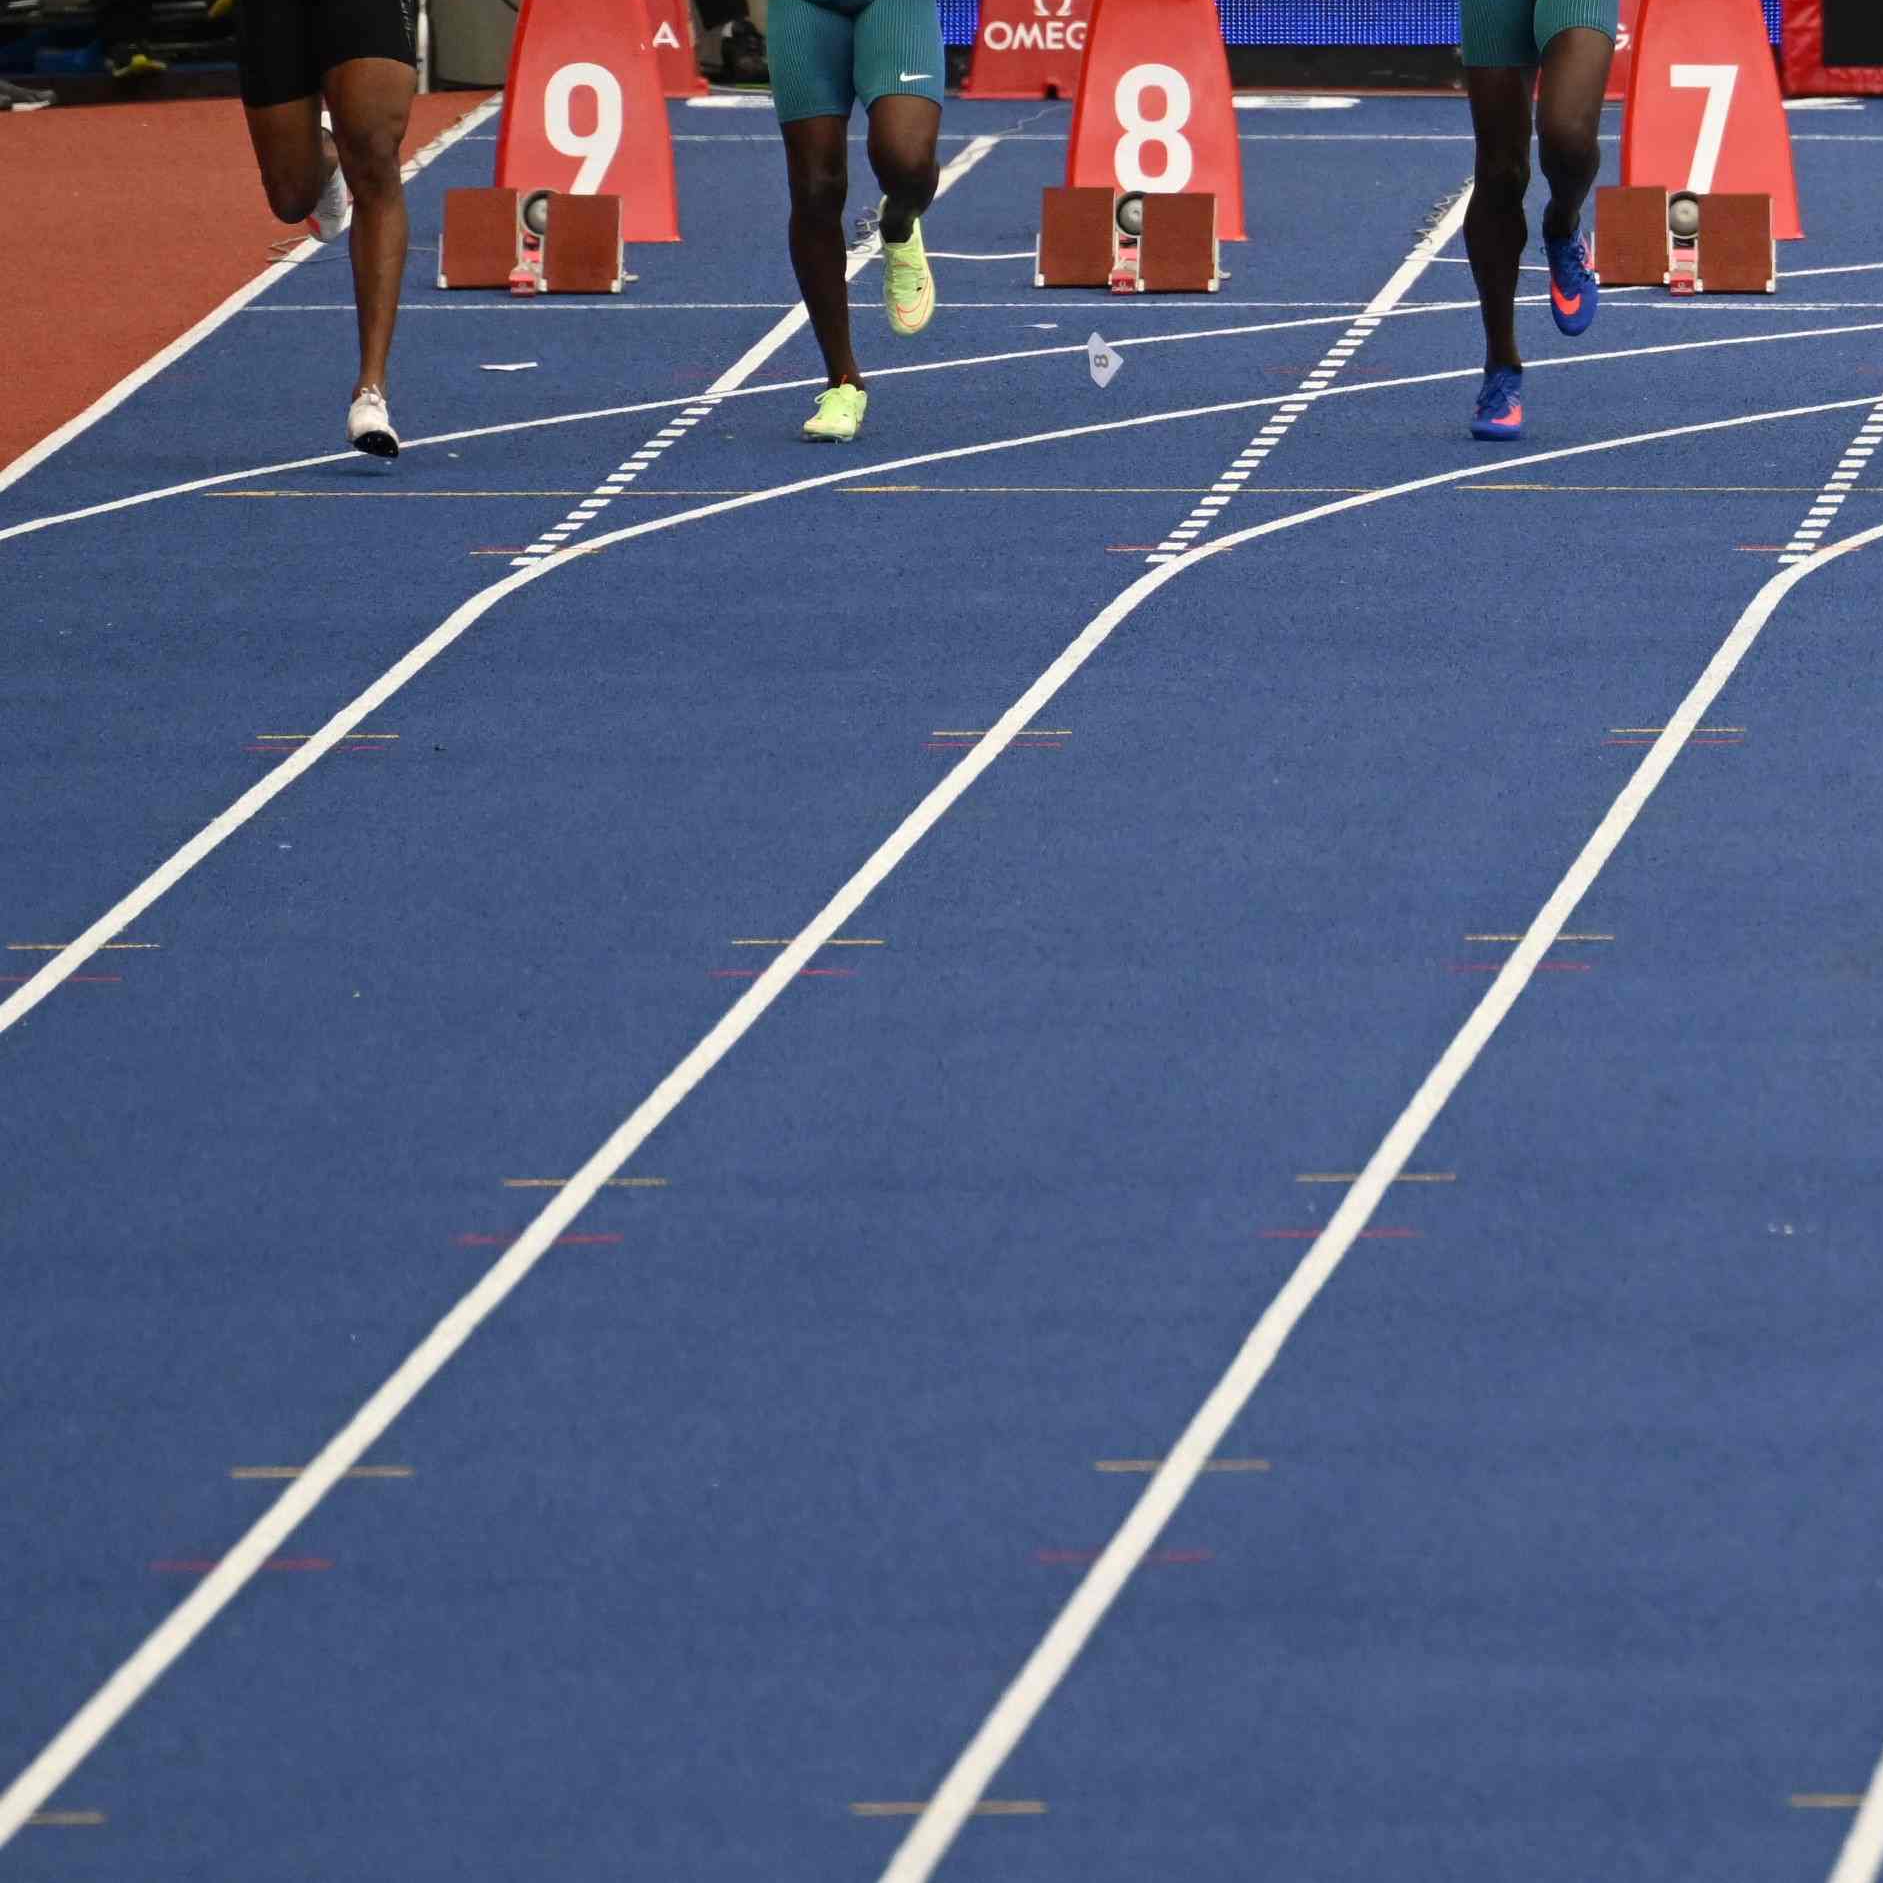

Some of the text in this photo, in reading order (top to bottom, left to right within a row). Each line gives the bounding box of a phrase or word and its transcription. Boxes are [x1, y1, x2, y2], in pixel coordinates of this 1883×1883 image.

[984, 21, 1088, 50] OMEG
[544, 62, 622, 195] 9
[1114, 63, 1193, 194] 8
[1670, 65, 1738, 195] 7
